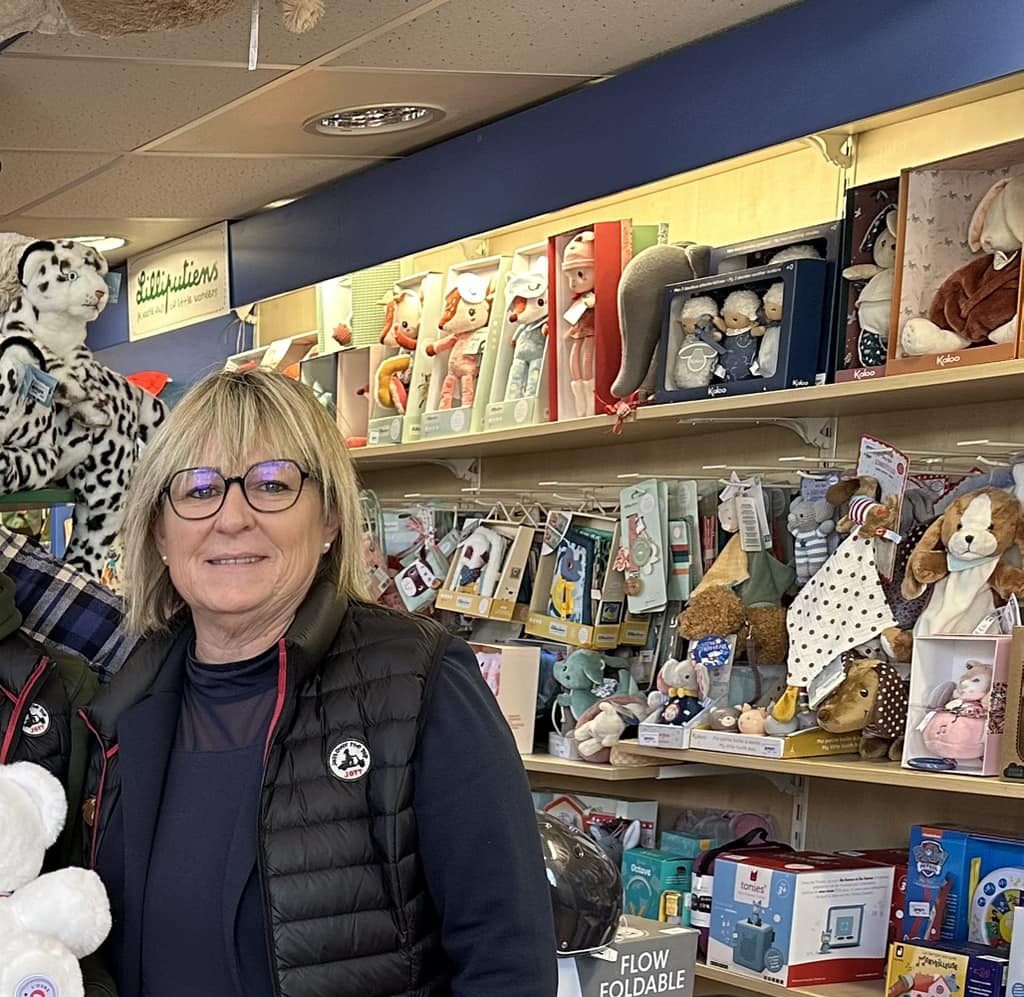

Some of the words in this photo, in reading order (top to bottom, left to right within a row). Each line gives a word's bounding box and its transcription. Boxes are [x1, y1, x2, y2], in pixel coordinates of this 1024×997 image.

[136, 260, 219, 314] Lilliputiens
[936, 355, 961, 366] Kaloo
[854, 369, 876, 380] Kaloo
[792, 379, 809, 387] Kaloo
[707, 386, 727, 396] Kaloo
[343, 769, 363, 778] JOTT
[621, 949, 670, 975] FLOW
